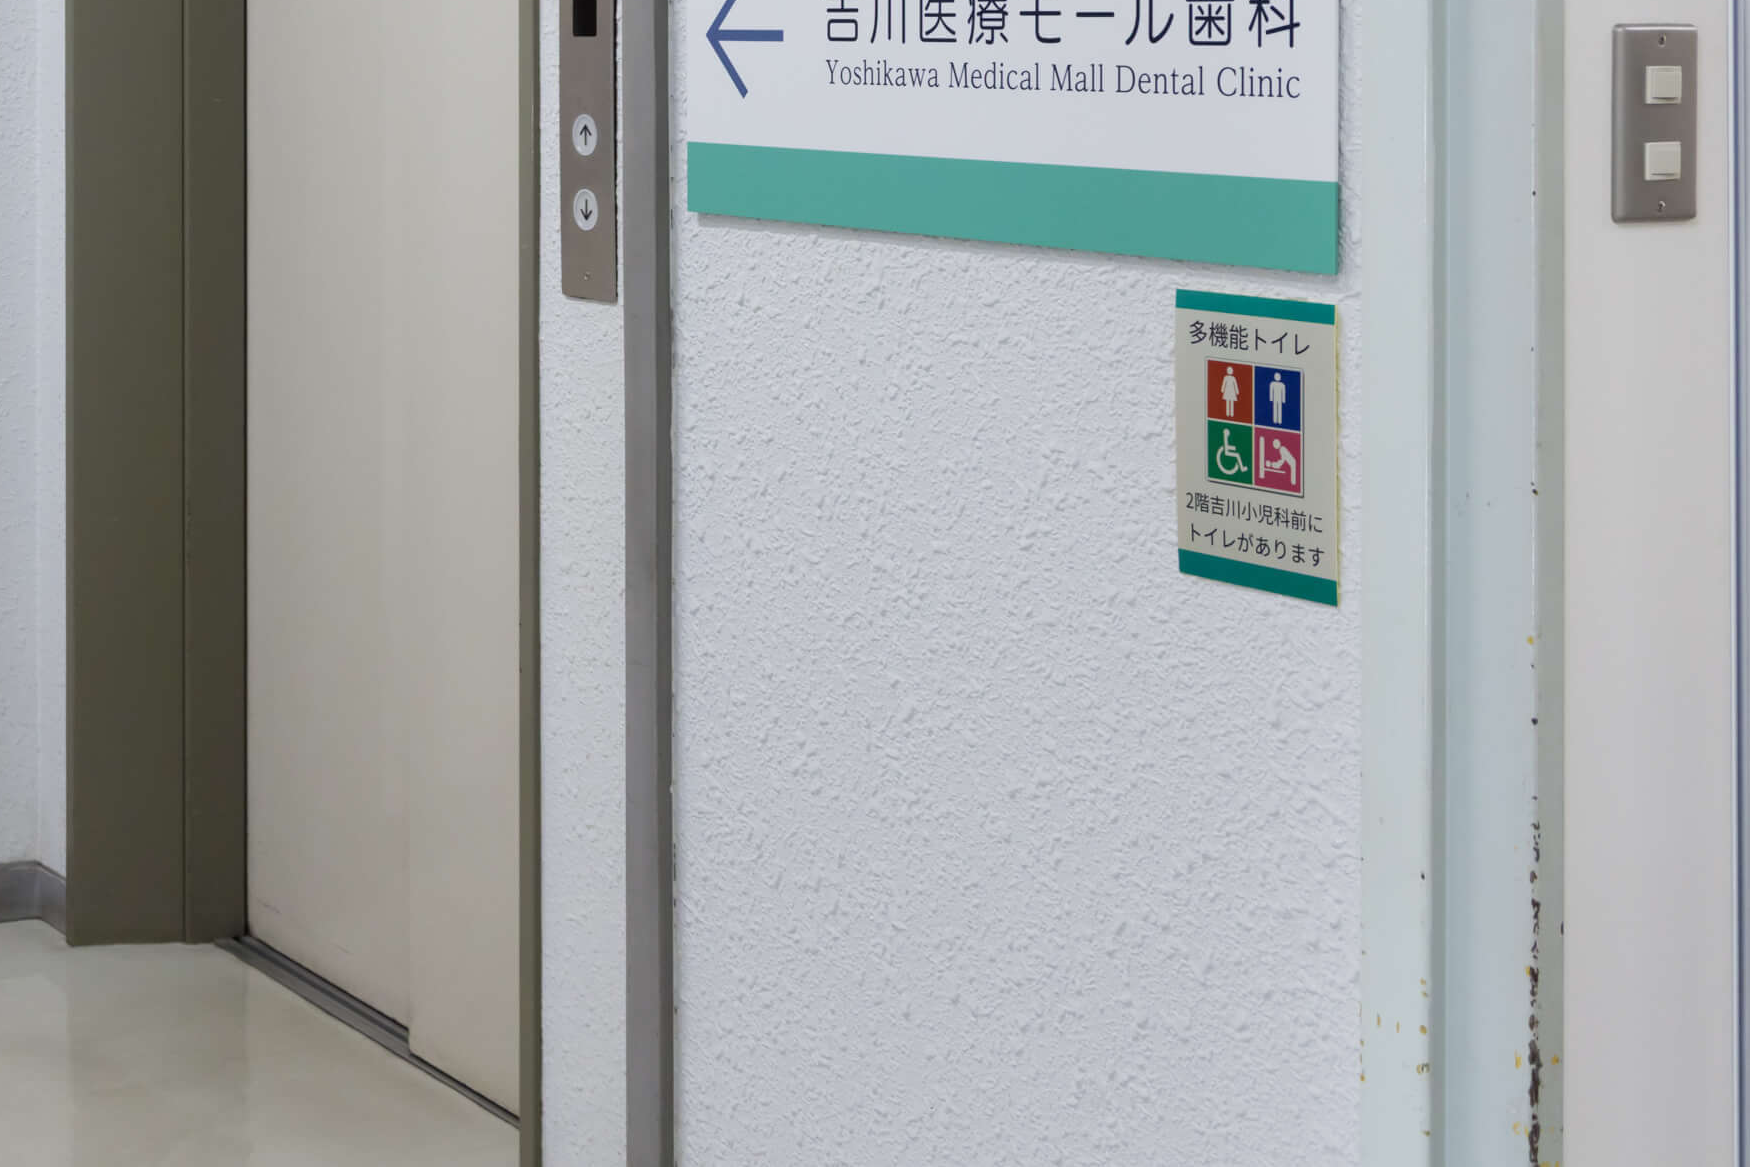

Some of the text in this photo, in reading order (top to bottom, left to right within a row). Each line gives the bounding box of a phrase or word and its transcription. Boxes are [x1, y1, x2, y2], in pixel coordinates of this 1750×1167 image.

[825, 59, 1301, 100] Yoshikawa Medical Mall Dental Clinic
[1188, 319, 1311, 356] 多機能トイレ
[1185, 491, 1324, 535] 2階吉川小児科前に
[1189, 522, 1326, 568] トイレがあります
